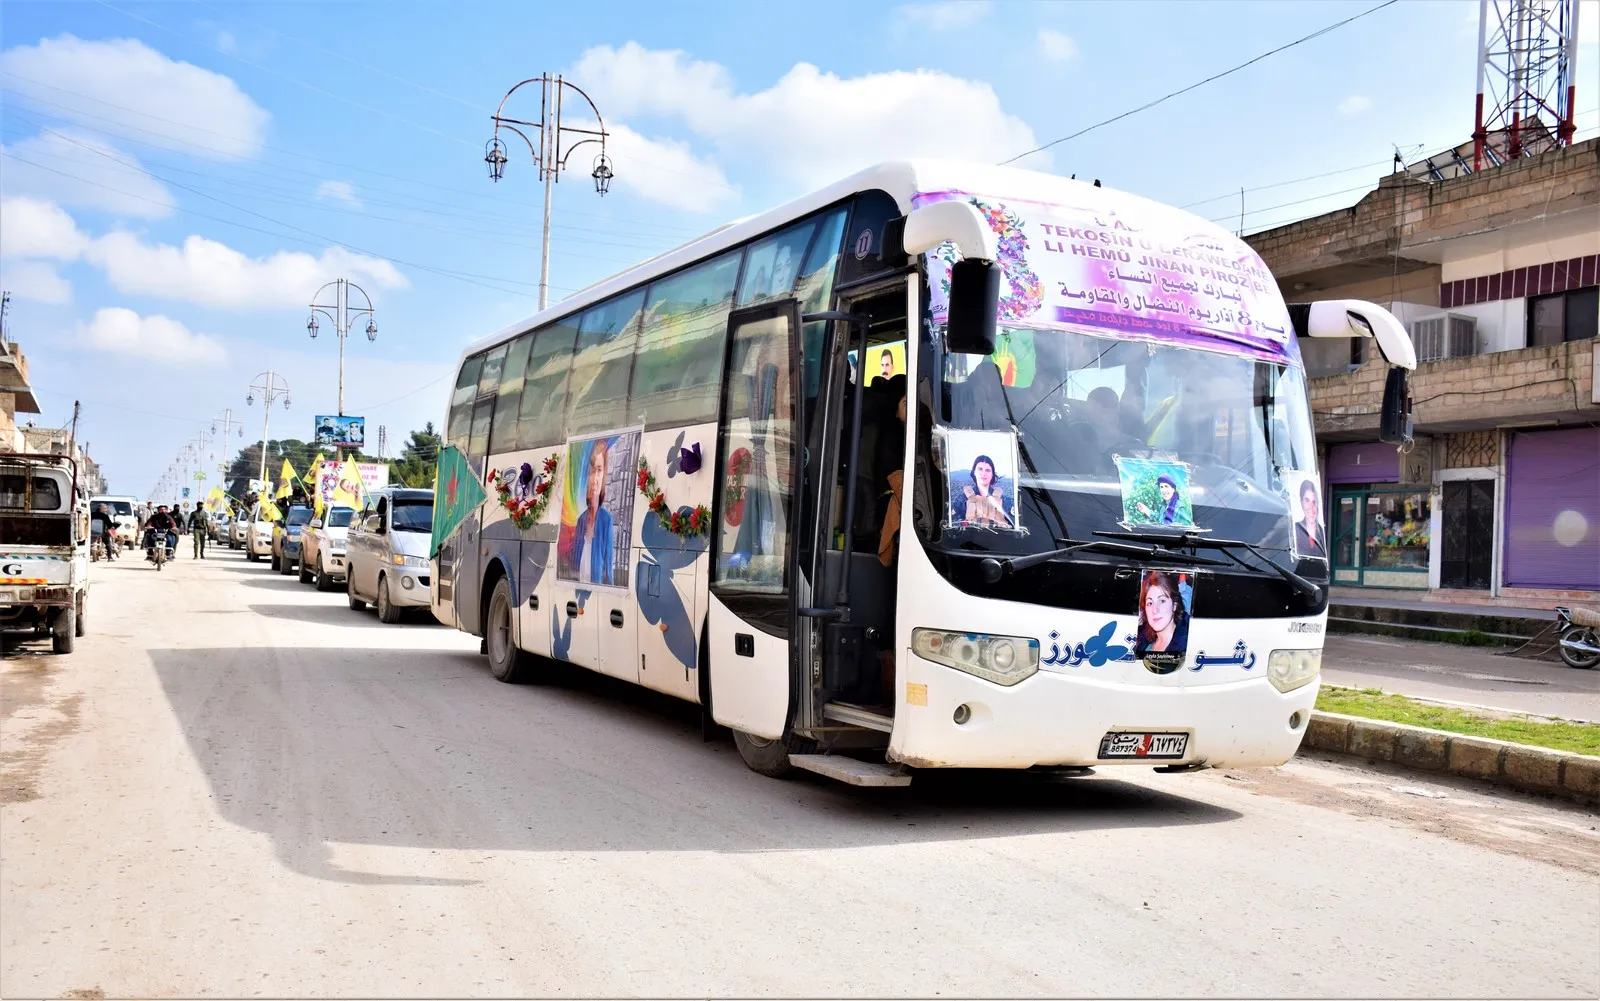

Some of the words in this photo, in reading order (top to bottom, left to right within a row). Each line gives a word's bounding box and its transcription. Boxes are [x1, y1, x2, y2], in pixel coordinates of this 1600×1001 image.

[1044, 240, 1065, 253] LI
[1138, 255, 1195, 275] JINAN
[1108, 267, 1158, 284] النساء
[1161, 278, 1199, 295] لجميع
[1237, 310, 1252, 326] 8
[1188, 639, 1256, 672] رشو
